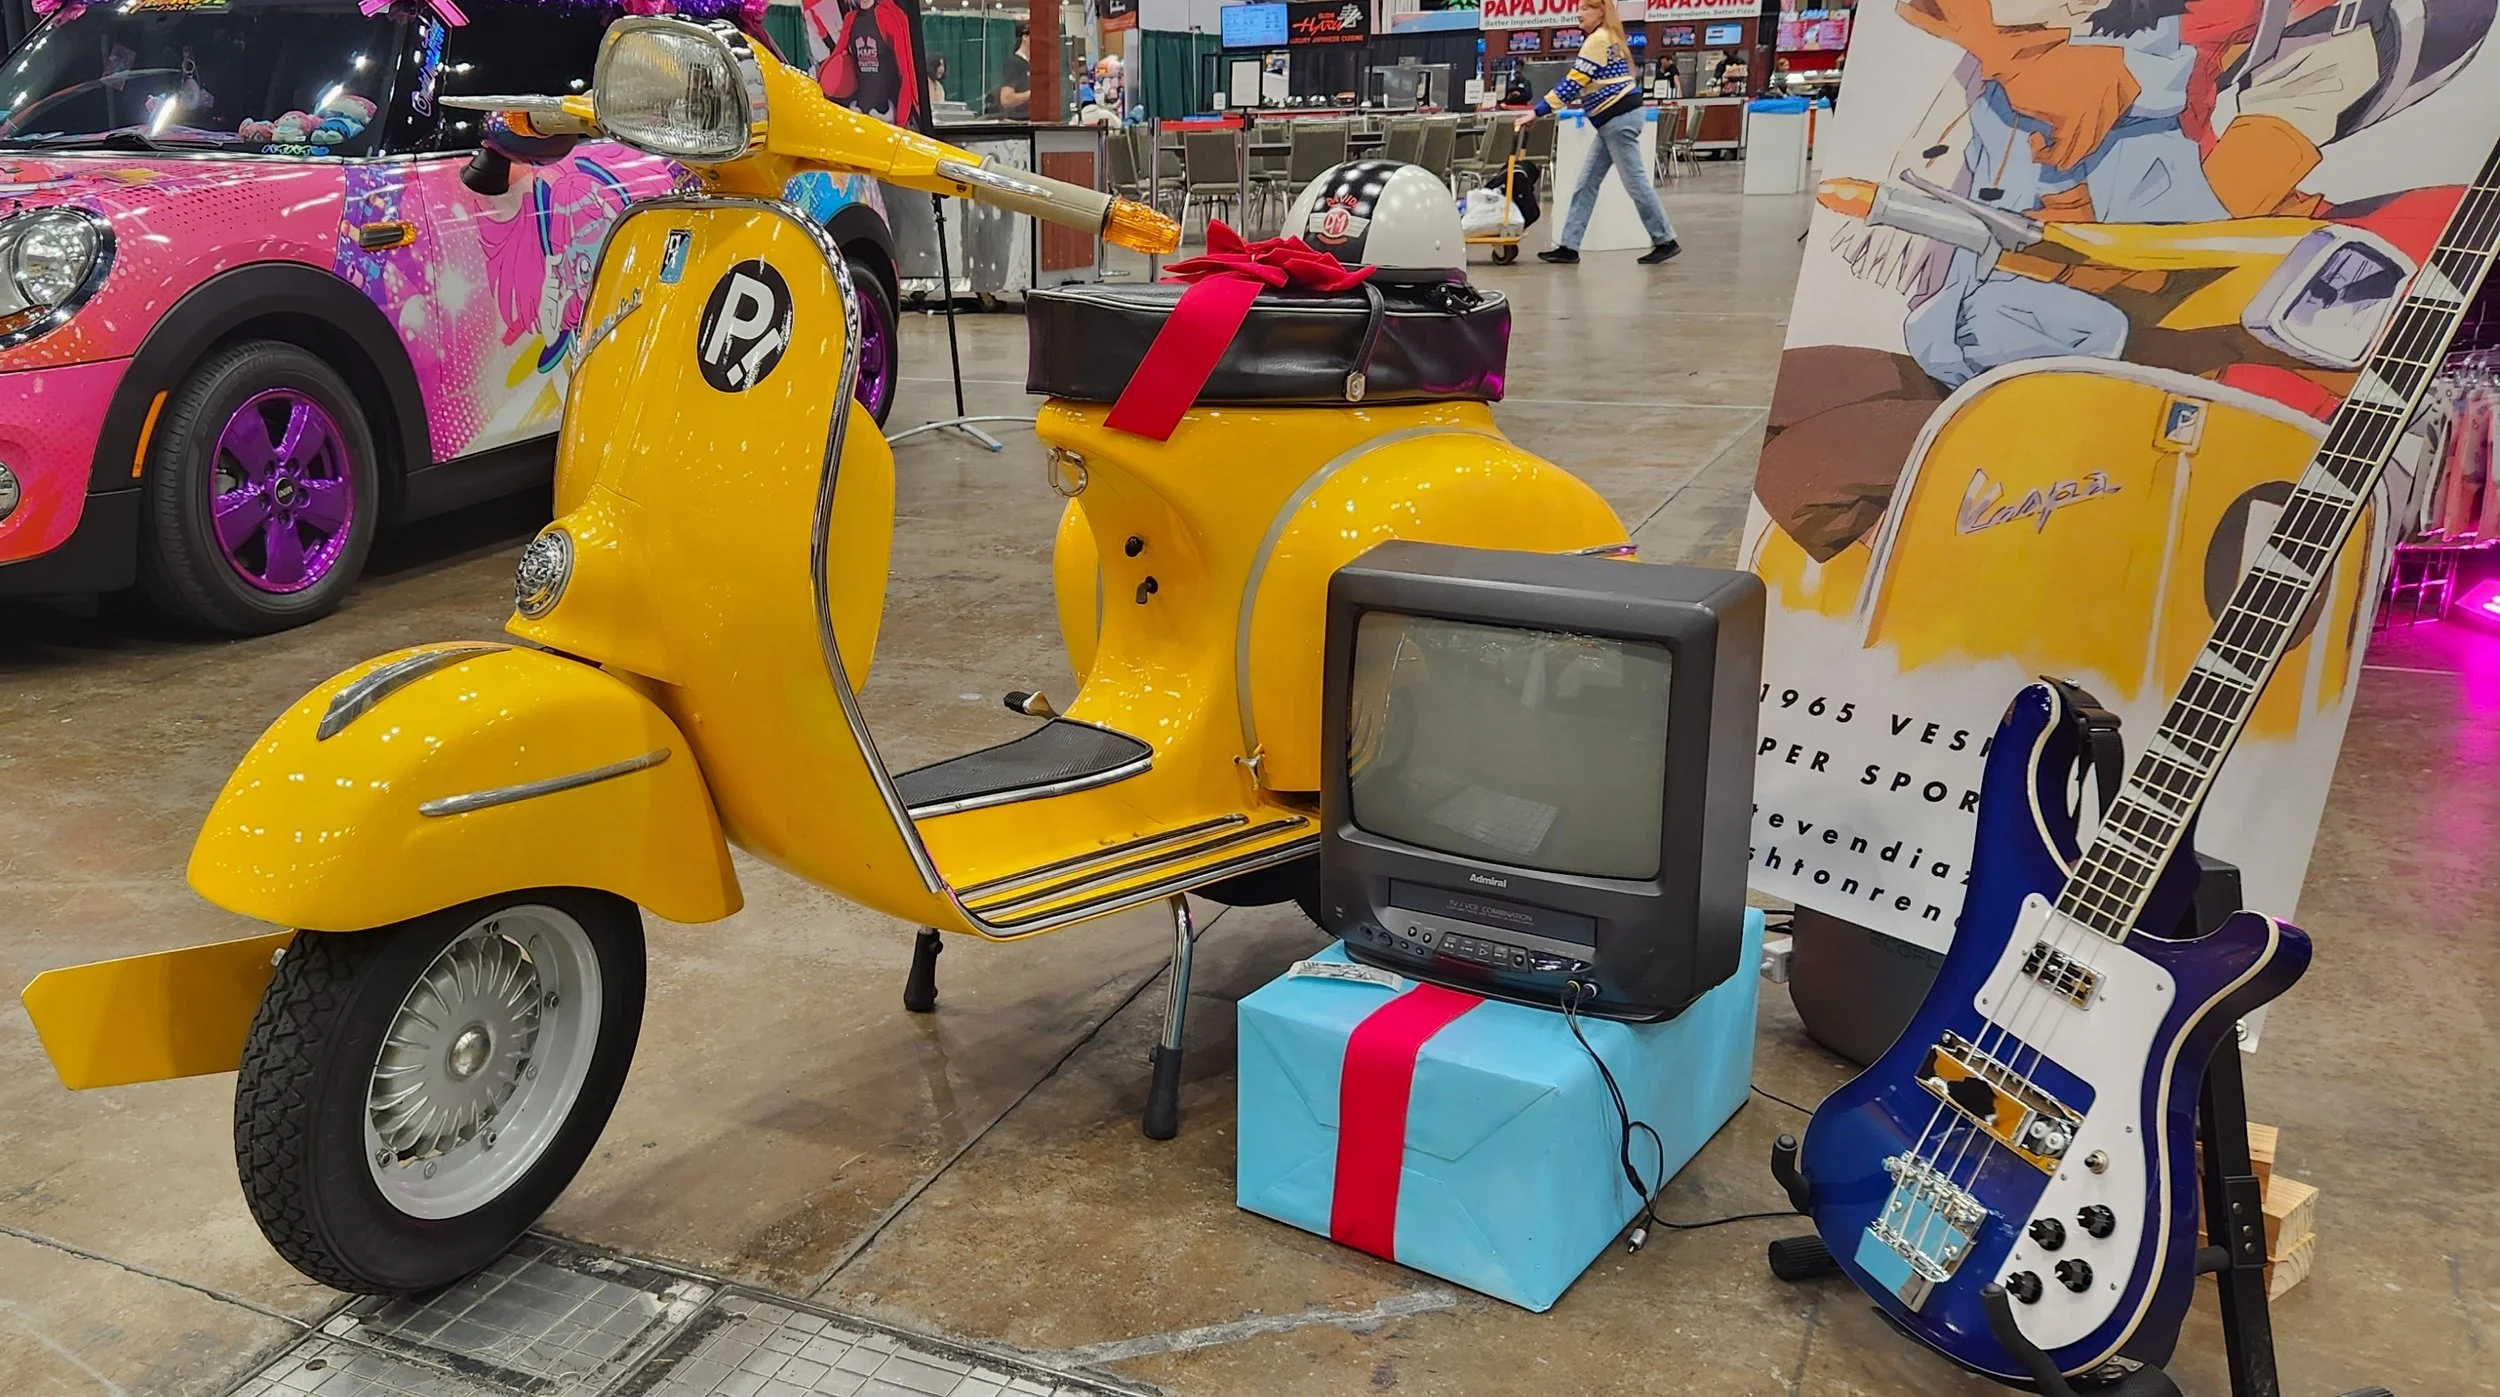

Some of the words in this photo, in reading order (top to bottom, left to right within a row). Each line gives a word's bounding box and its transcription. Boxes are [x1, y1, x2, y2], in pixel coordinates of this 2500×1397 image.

[1484, 0, 1536, 18] PAPA
[1539, 0, 1580, 15] JOH
[1326, 193, 1358, 207] DAVID
[1759, 683, 1856, 723] 1965
[1757, 737, 1830, 773] PER
[1860, 764, 1980, 813] SPOR
[1469, 873, 1507, 888] Admiral
[1871, 936, 1940, 971] ECOFL
